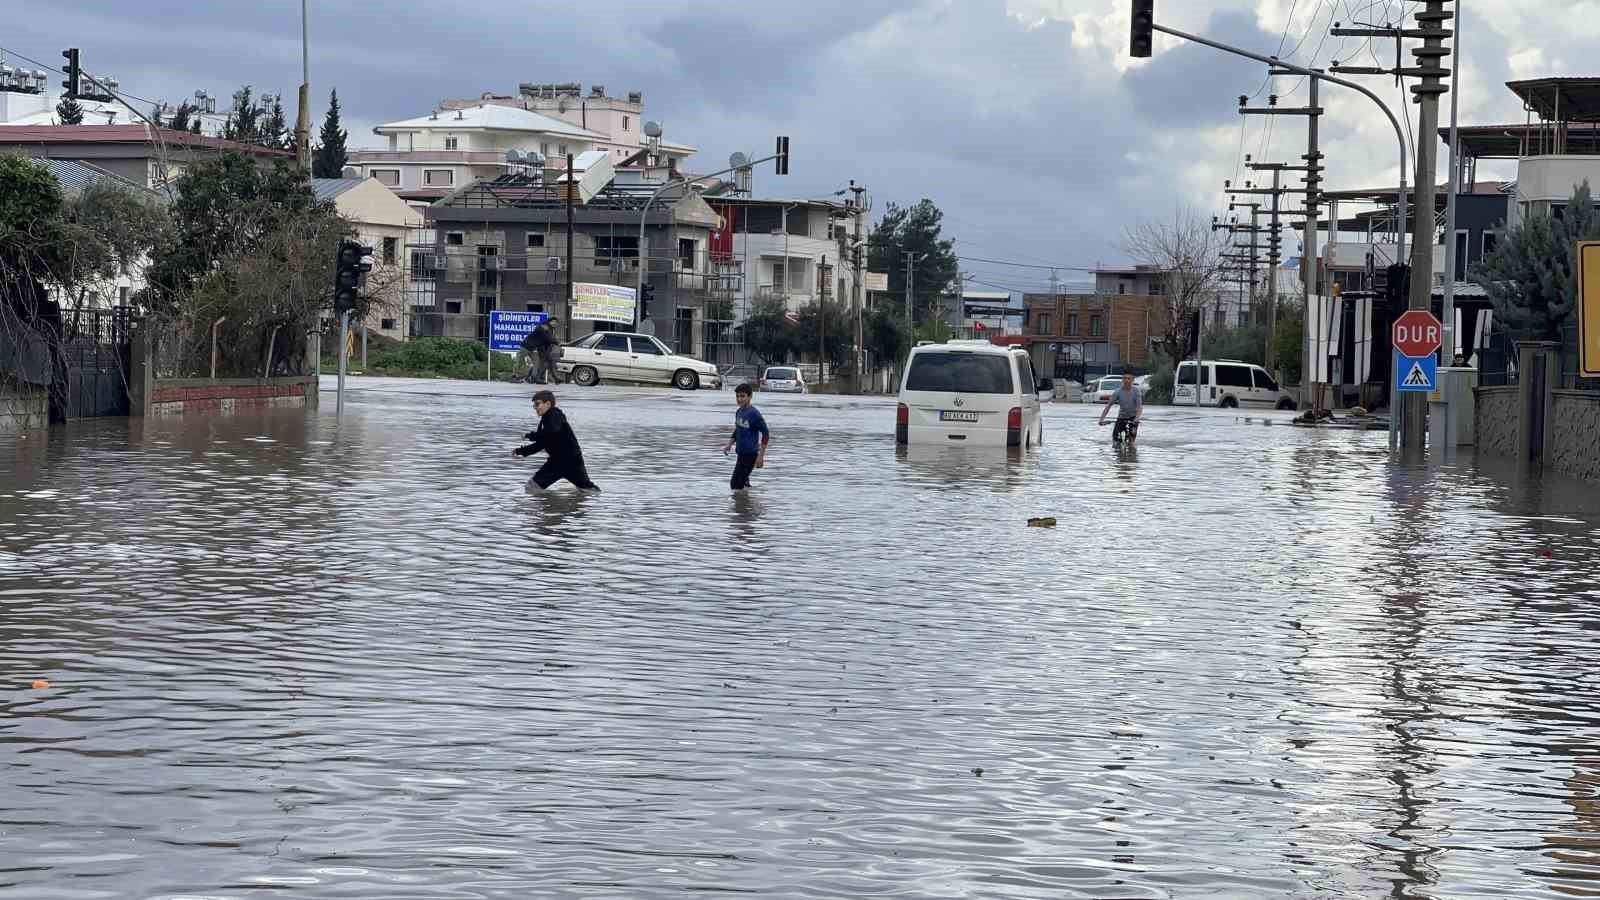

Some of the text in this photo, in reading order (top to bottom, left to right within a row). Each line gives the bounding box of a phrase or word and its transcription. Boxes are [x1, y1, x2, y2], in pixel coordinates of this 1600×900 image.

[498, 312, 540, 323] ŞİRİNEVLER
[494, 333, 509, 342] HOŞ
[1397, 325, 1438, 343] DUR
